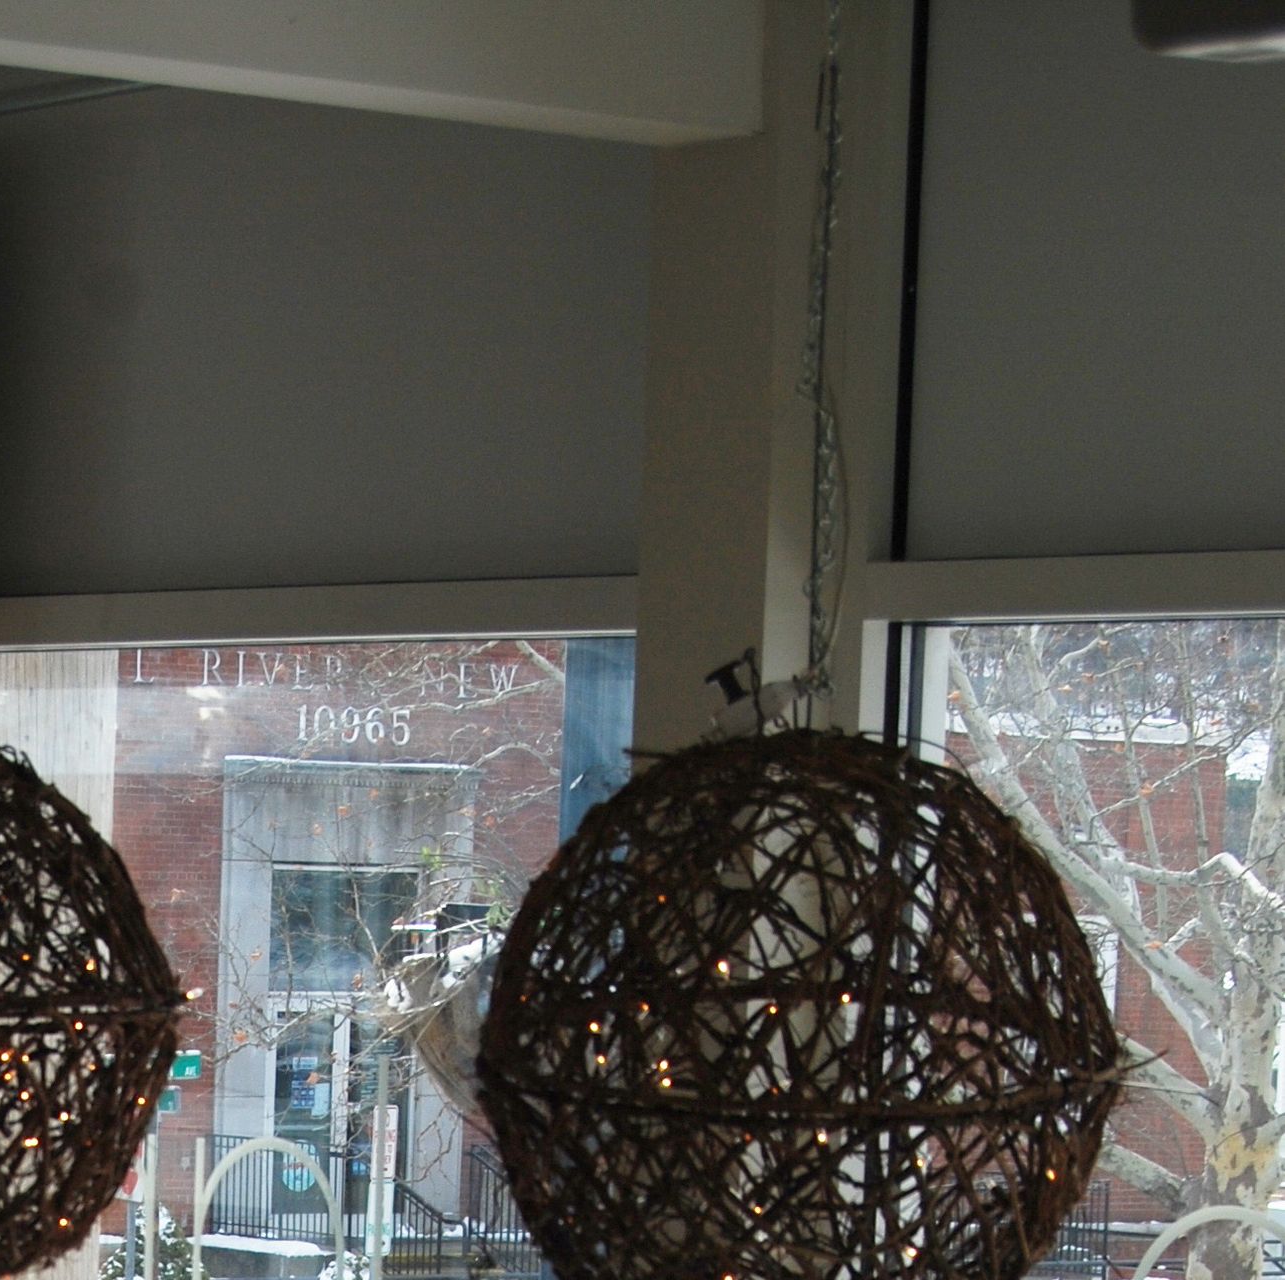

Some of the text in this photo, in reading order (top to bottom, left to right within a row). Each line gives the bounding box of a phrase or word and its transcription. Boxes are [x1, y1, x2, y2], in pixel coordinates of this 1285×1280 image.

[202, 650, 343, 691] RIVER
[417, 659, 519, 698] NEW
[297, 703, 411, 746] 10965
